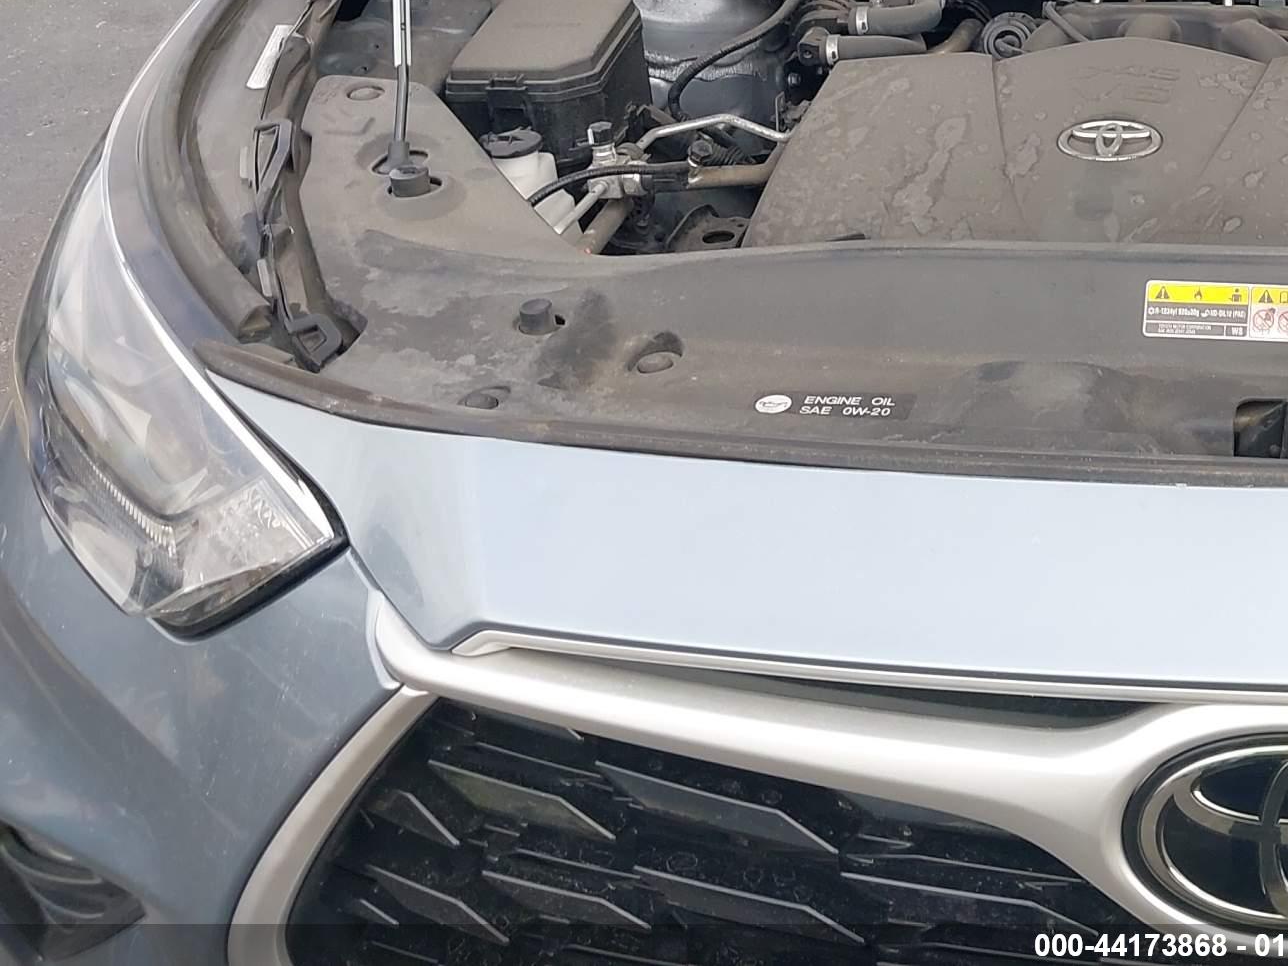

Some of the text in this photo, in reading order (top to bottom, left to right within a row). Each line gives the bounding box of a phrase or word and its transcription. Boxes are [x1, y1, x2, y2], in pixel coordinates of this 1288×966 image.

[804, 396, 895, 406] ENGINE OIL
[799, 406, 891, 417] SAE 0W-20
